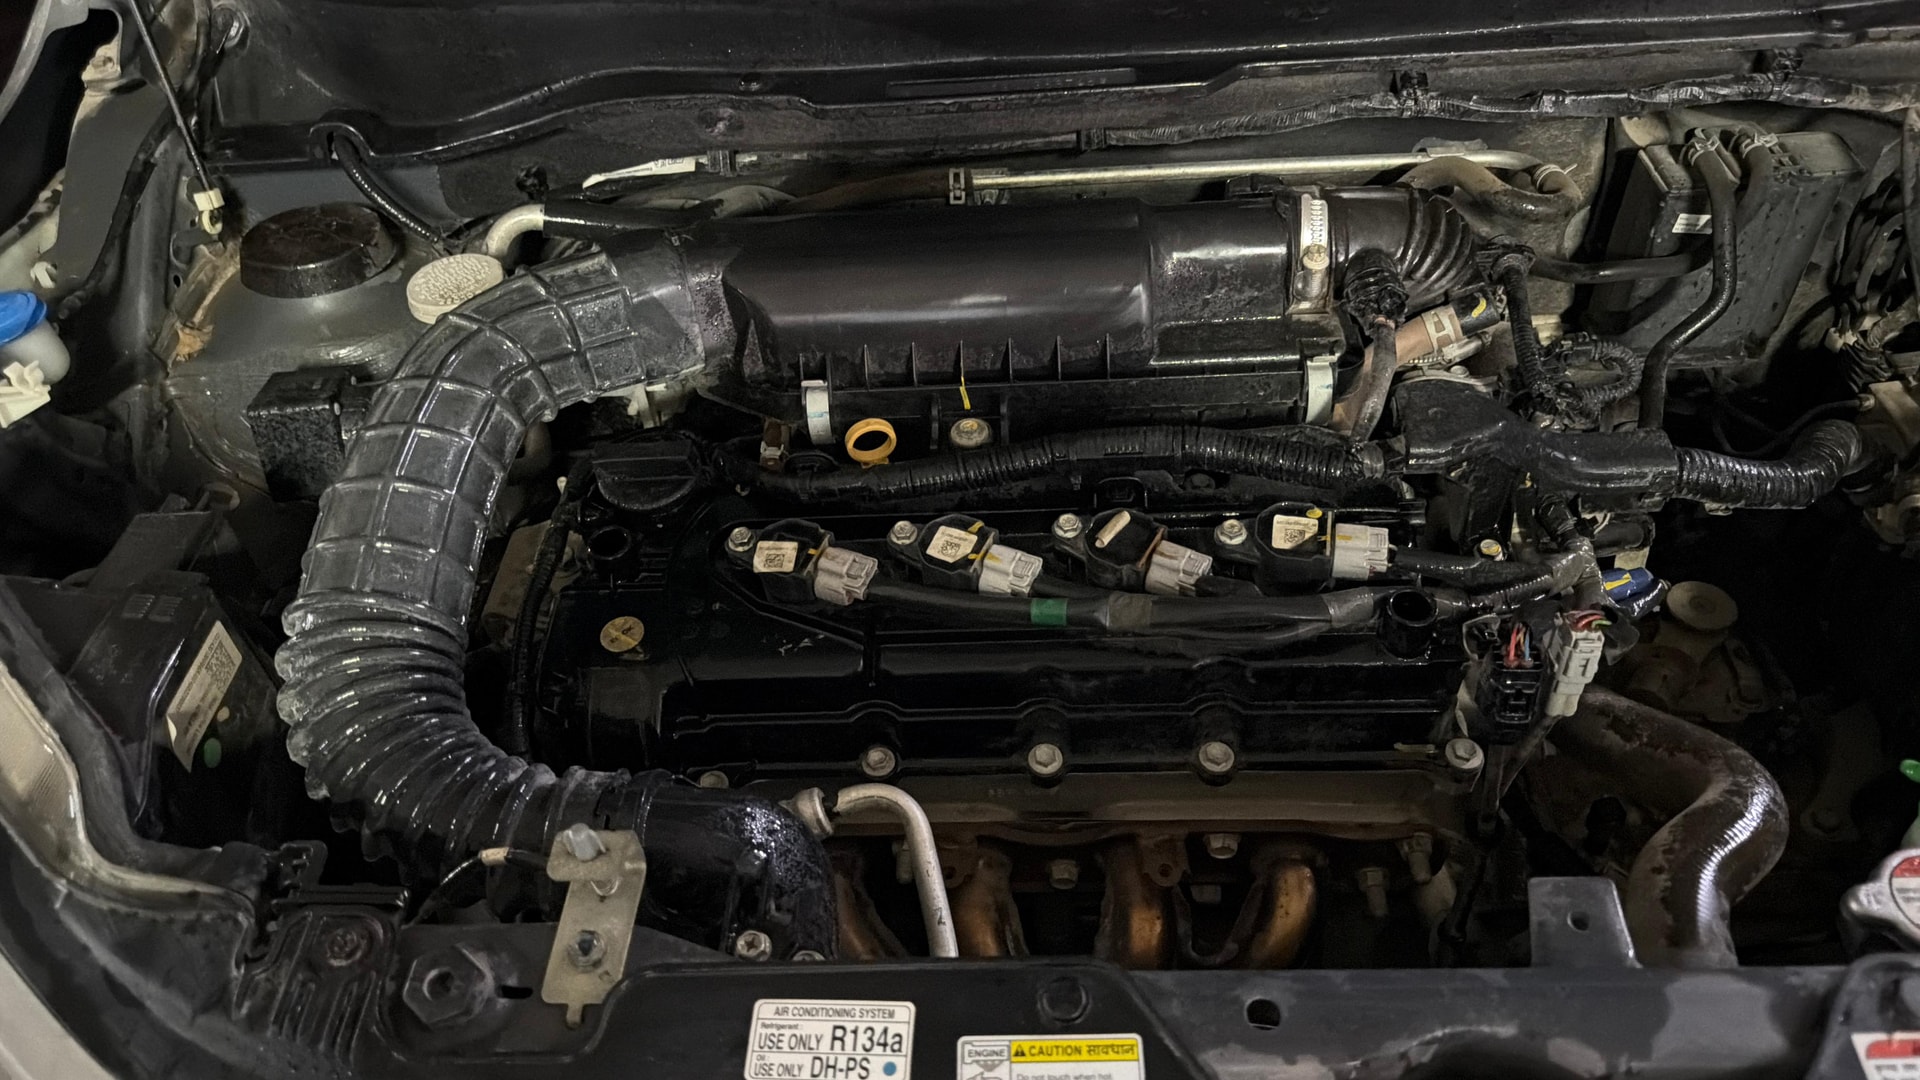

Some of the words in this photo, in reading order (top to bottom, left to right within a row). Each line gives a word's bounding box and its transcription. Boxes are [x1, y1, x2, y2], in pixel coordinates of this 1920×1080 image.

[774, 1006, 790, 1016] AIR
[791, 1006, 857, 1018] CONDITIONING
[858, 1007, 896, 1019] SYSTEM
[757, 1032, 786, 1050] USE
[788, 1033, 824, 1051] ONLY
[829, 1024, 904, 1053] R134a
[967, 1048, 1006, 1058] ENGINE
[1030, 1045, 1082, 1057] CAUTION
[754, 1061, 776, 1077] USE
[776, 1062, 805, 1078] ONLY
[810, 1056, 872, 1080] DH-PS
